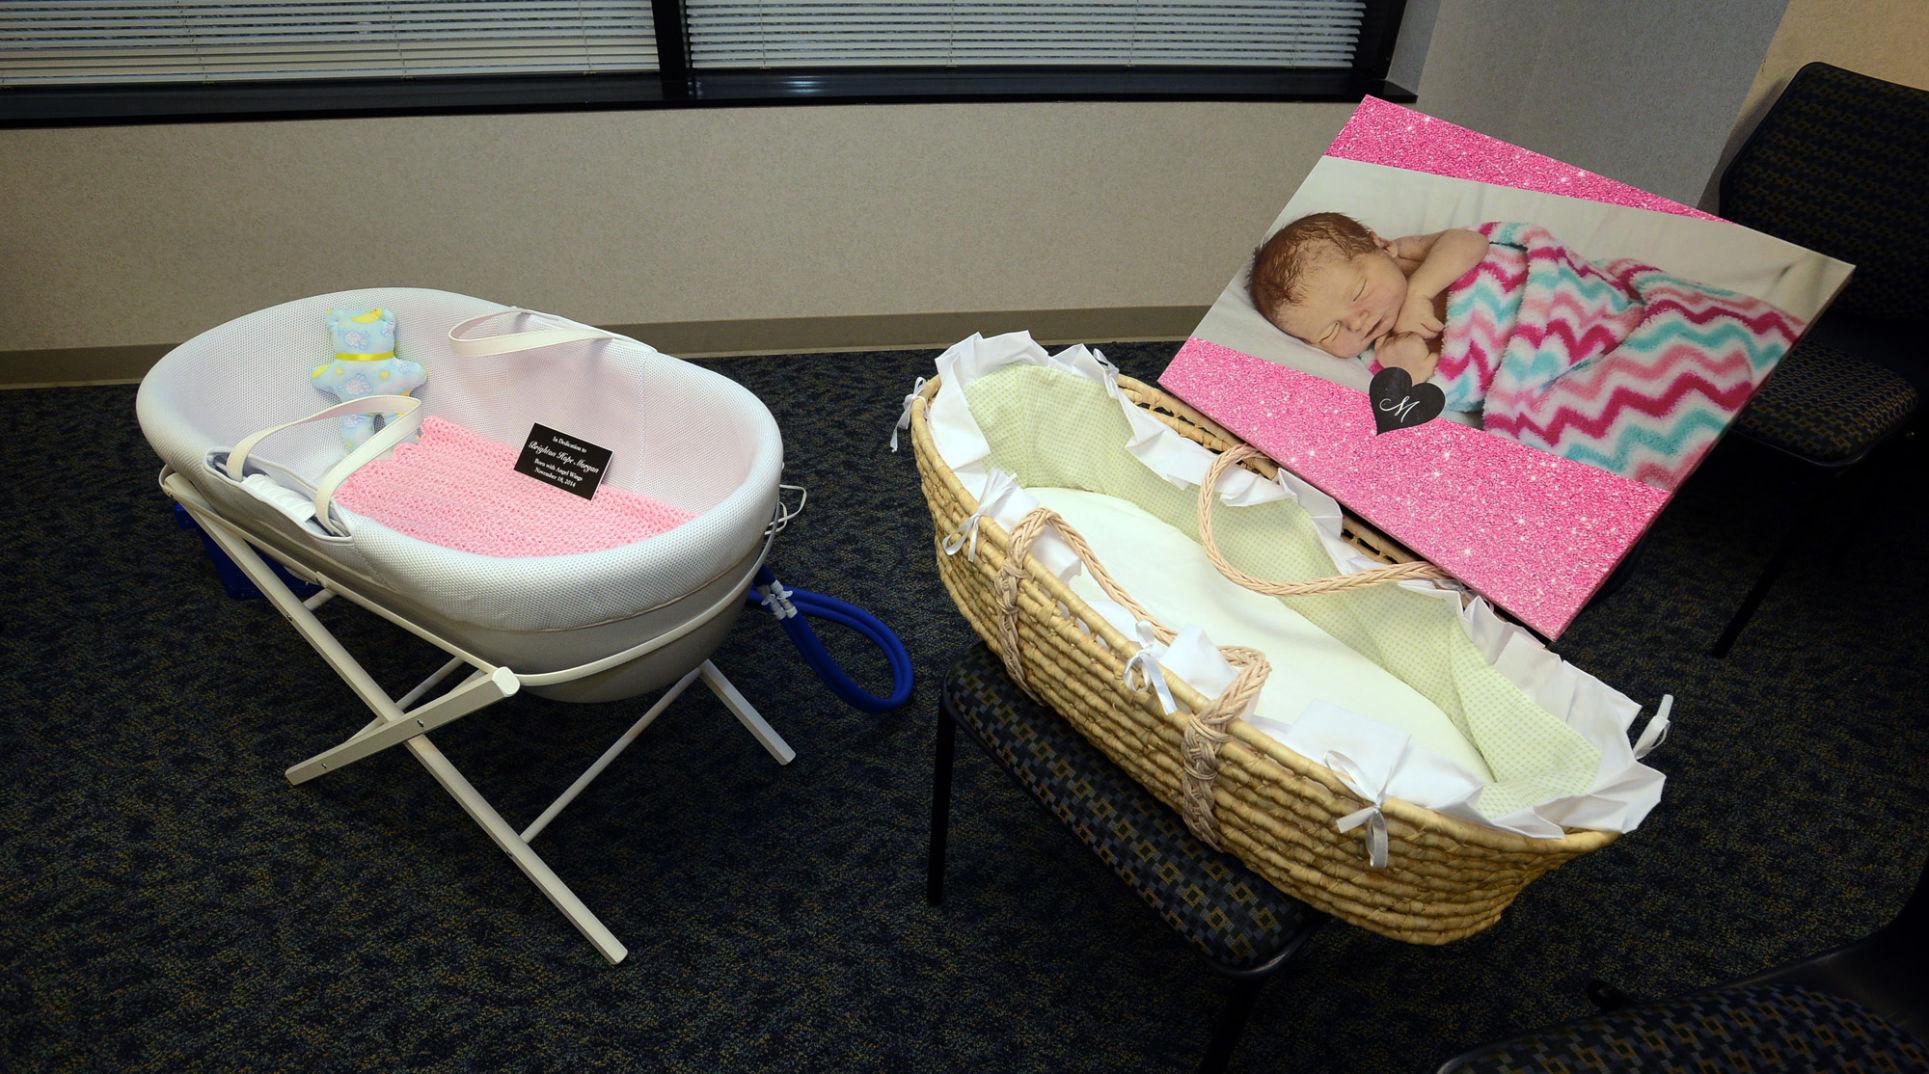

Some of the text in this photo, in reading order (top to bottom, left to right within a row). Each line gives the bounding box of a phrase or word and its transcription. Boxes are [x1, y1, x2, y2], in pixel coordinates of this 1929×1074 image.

[1380, 396, 1420, 423] M
[528, 440, 599, 473] Brighton Hope Morgan
[534, 458, 546, 467] Born
[555, 467, 570, 476] Angel
[570, 471, 583, 482] Wings
[534, 466, 557, 480] November
